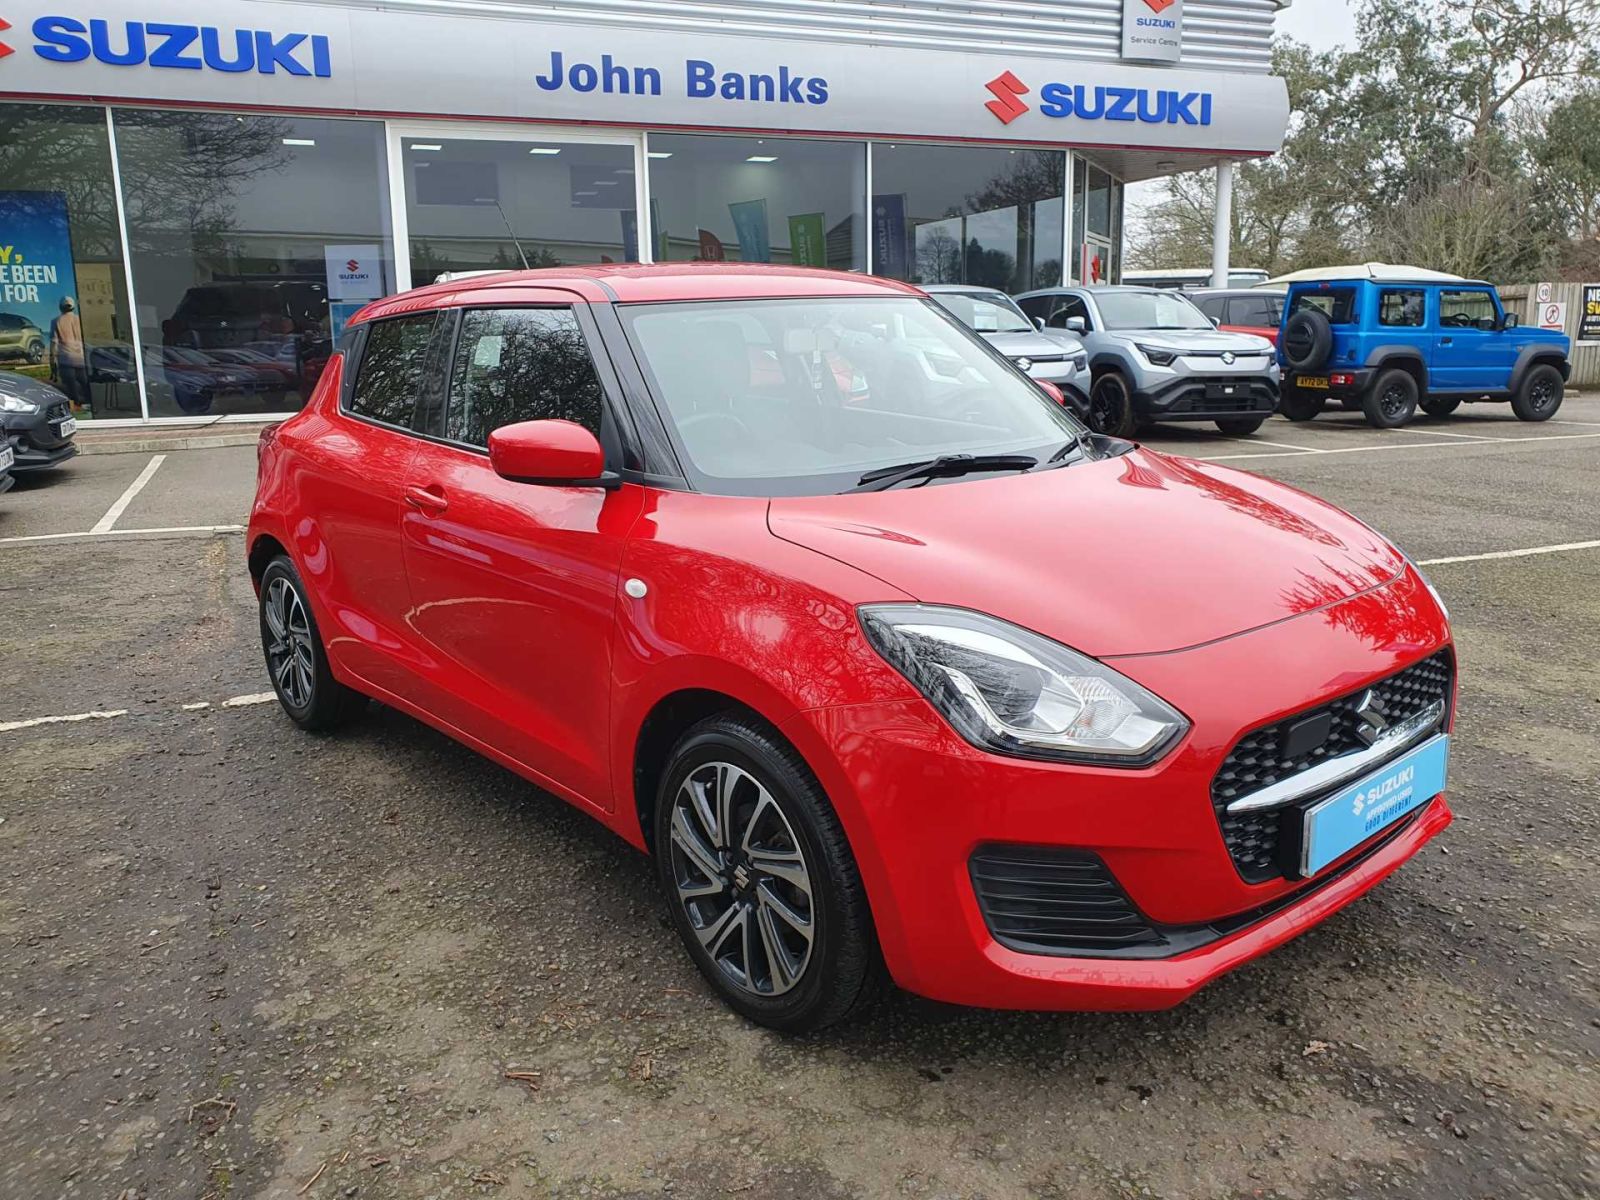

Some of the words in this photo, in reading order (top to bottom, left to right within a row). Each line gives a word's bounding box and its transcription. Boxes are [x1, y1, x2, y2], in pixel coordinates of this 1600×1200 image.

[1136, 17, 1175, 29] SUZUKI
[32, 16, 331, 78] SUZUKI
[1130, 36, 1157, 44] Service
[1158, 38, 1178, 47] Centre
[535, 51, 661, 96] John
[686, 59, 829, 105] Banks
[1040, 83, 1212, 126] SUZUKI
[11, 265, 58, 284] BEEN
[4, 284, 40, 303] FOR
[1367, 765, 1414, 805] SUZUKI
[1365, 814, 1380, 832] GOOD
